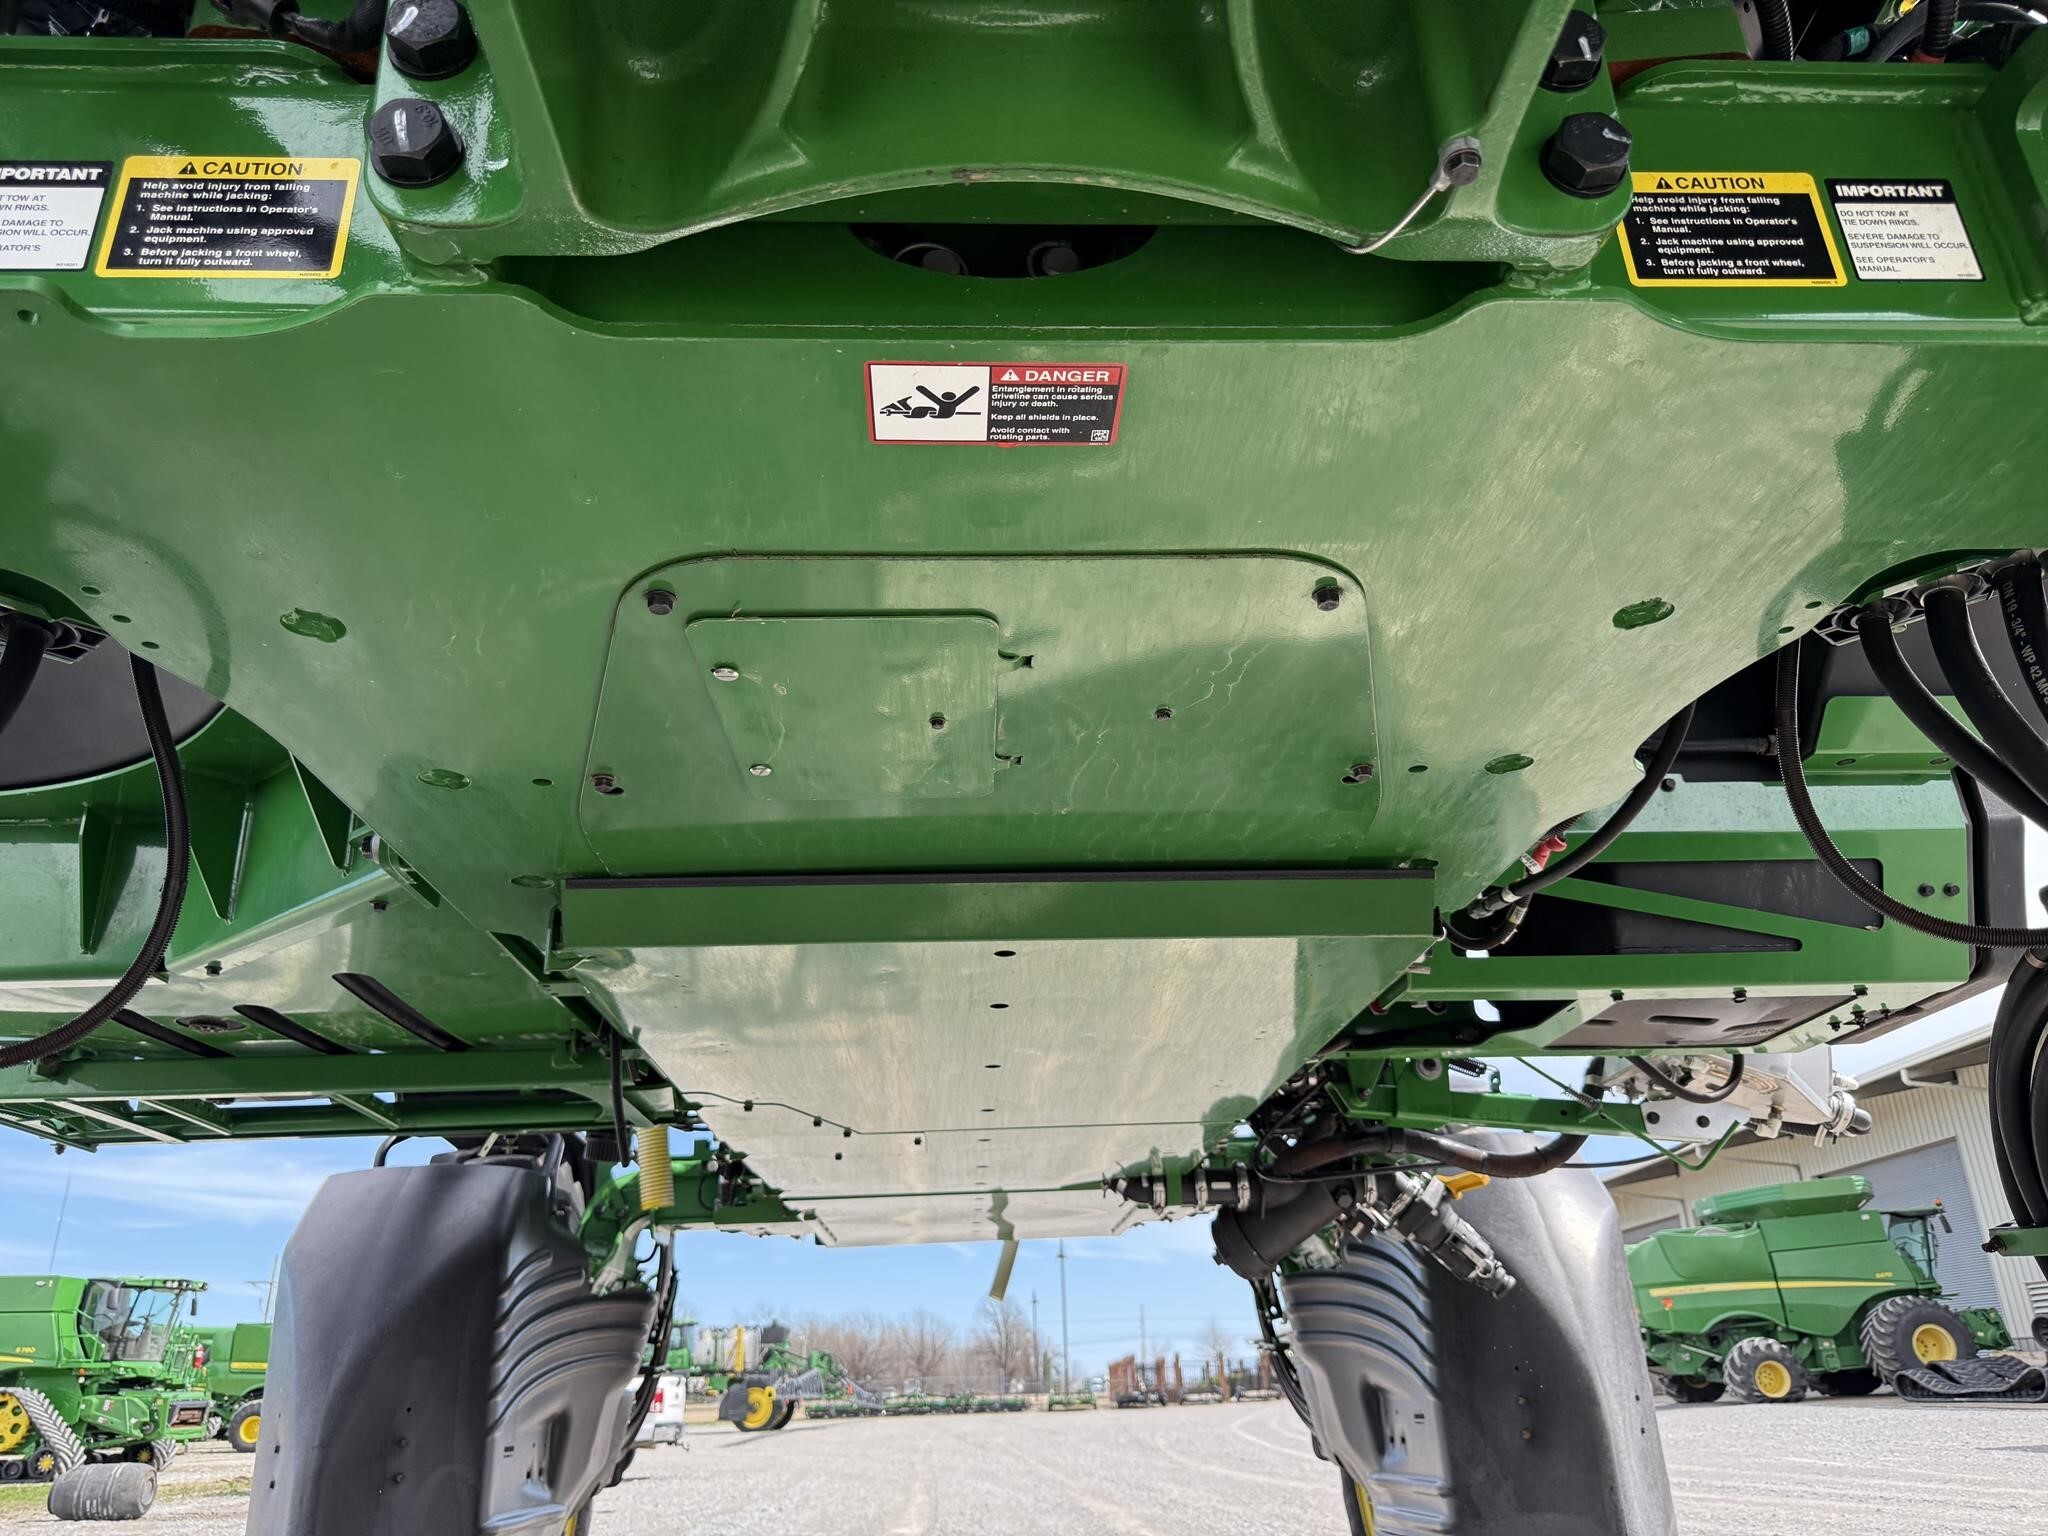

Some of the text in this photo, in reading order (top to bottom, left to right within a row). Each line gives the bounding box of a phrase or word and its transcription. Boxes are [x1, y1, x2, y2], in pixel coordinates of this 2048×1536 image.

[203, 162, 303, 175] CAUTION
[143, 182, 168, 191] Help
[208, 182, 241, 192] injury
[274, 184, 309, 192] falling
[1675, 177, 1764, 189] CAUTION
[140, 191, 189, 199] machine
[226, 192, 272, 201] jacking:
[1835, 185, 1943, 197] IMPORTANT
[1688, 196, 1717, 206] injury
[1747, 196, 1780, 205] falling
[260, 206, 318, 214] Operator's
[227, 227, 258, 236] using
[261, 228, 313, 236] approved
[144, 235, 207, 244] equipment.
[1727, 238, 1754, 246] using
[1757, 238, 1803, 246] approved
[181, 249, 223, 258] jacking
[266, 250, 301, 258] wheel,
[176, 258, 201, 267] fully
[1698, 259, 1734, 268] jacking
[1697, 268, 1718, 276] fully
[1025, 370, 1109, 382] DANGER
[1068, 386, 1102, 394] rotating
[992, 400, 1017, 408] injury
[2002, 580, 2014, 598] DN
[2006, 599, 2018, 613] 19
[2021, 644, 2036, 664] WP
[2030, 664, 2042, 680] 42
